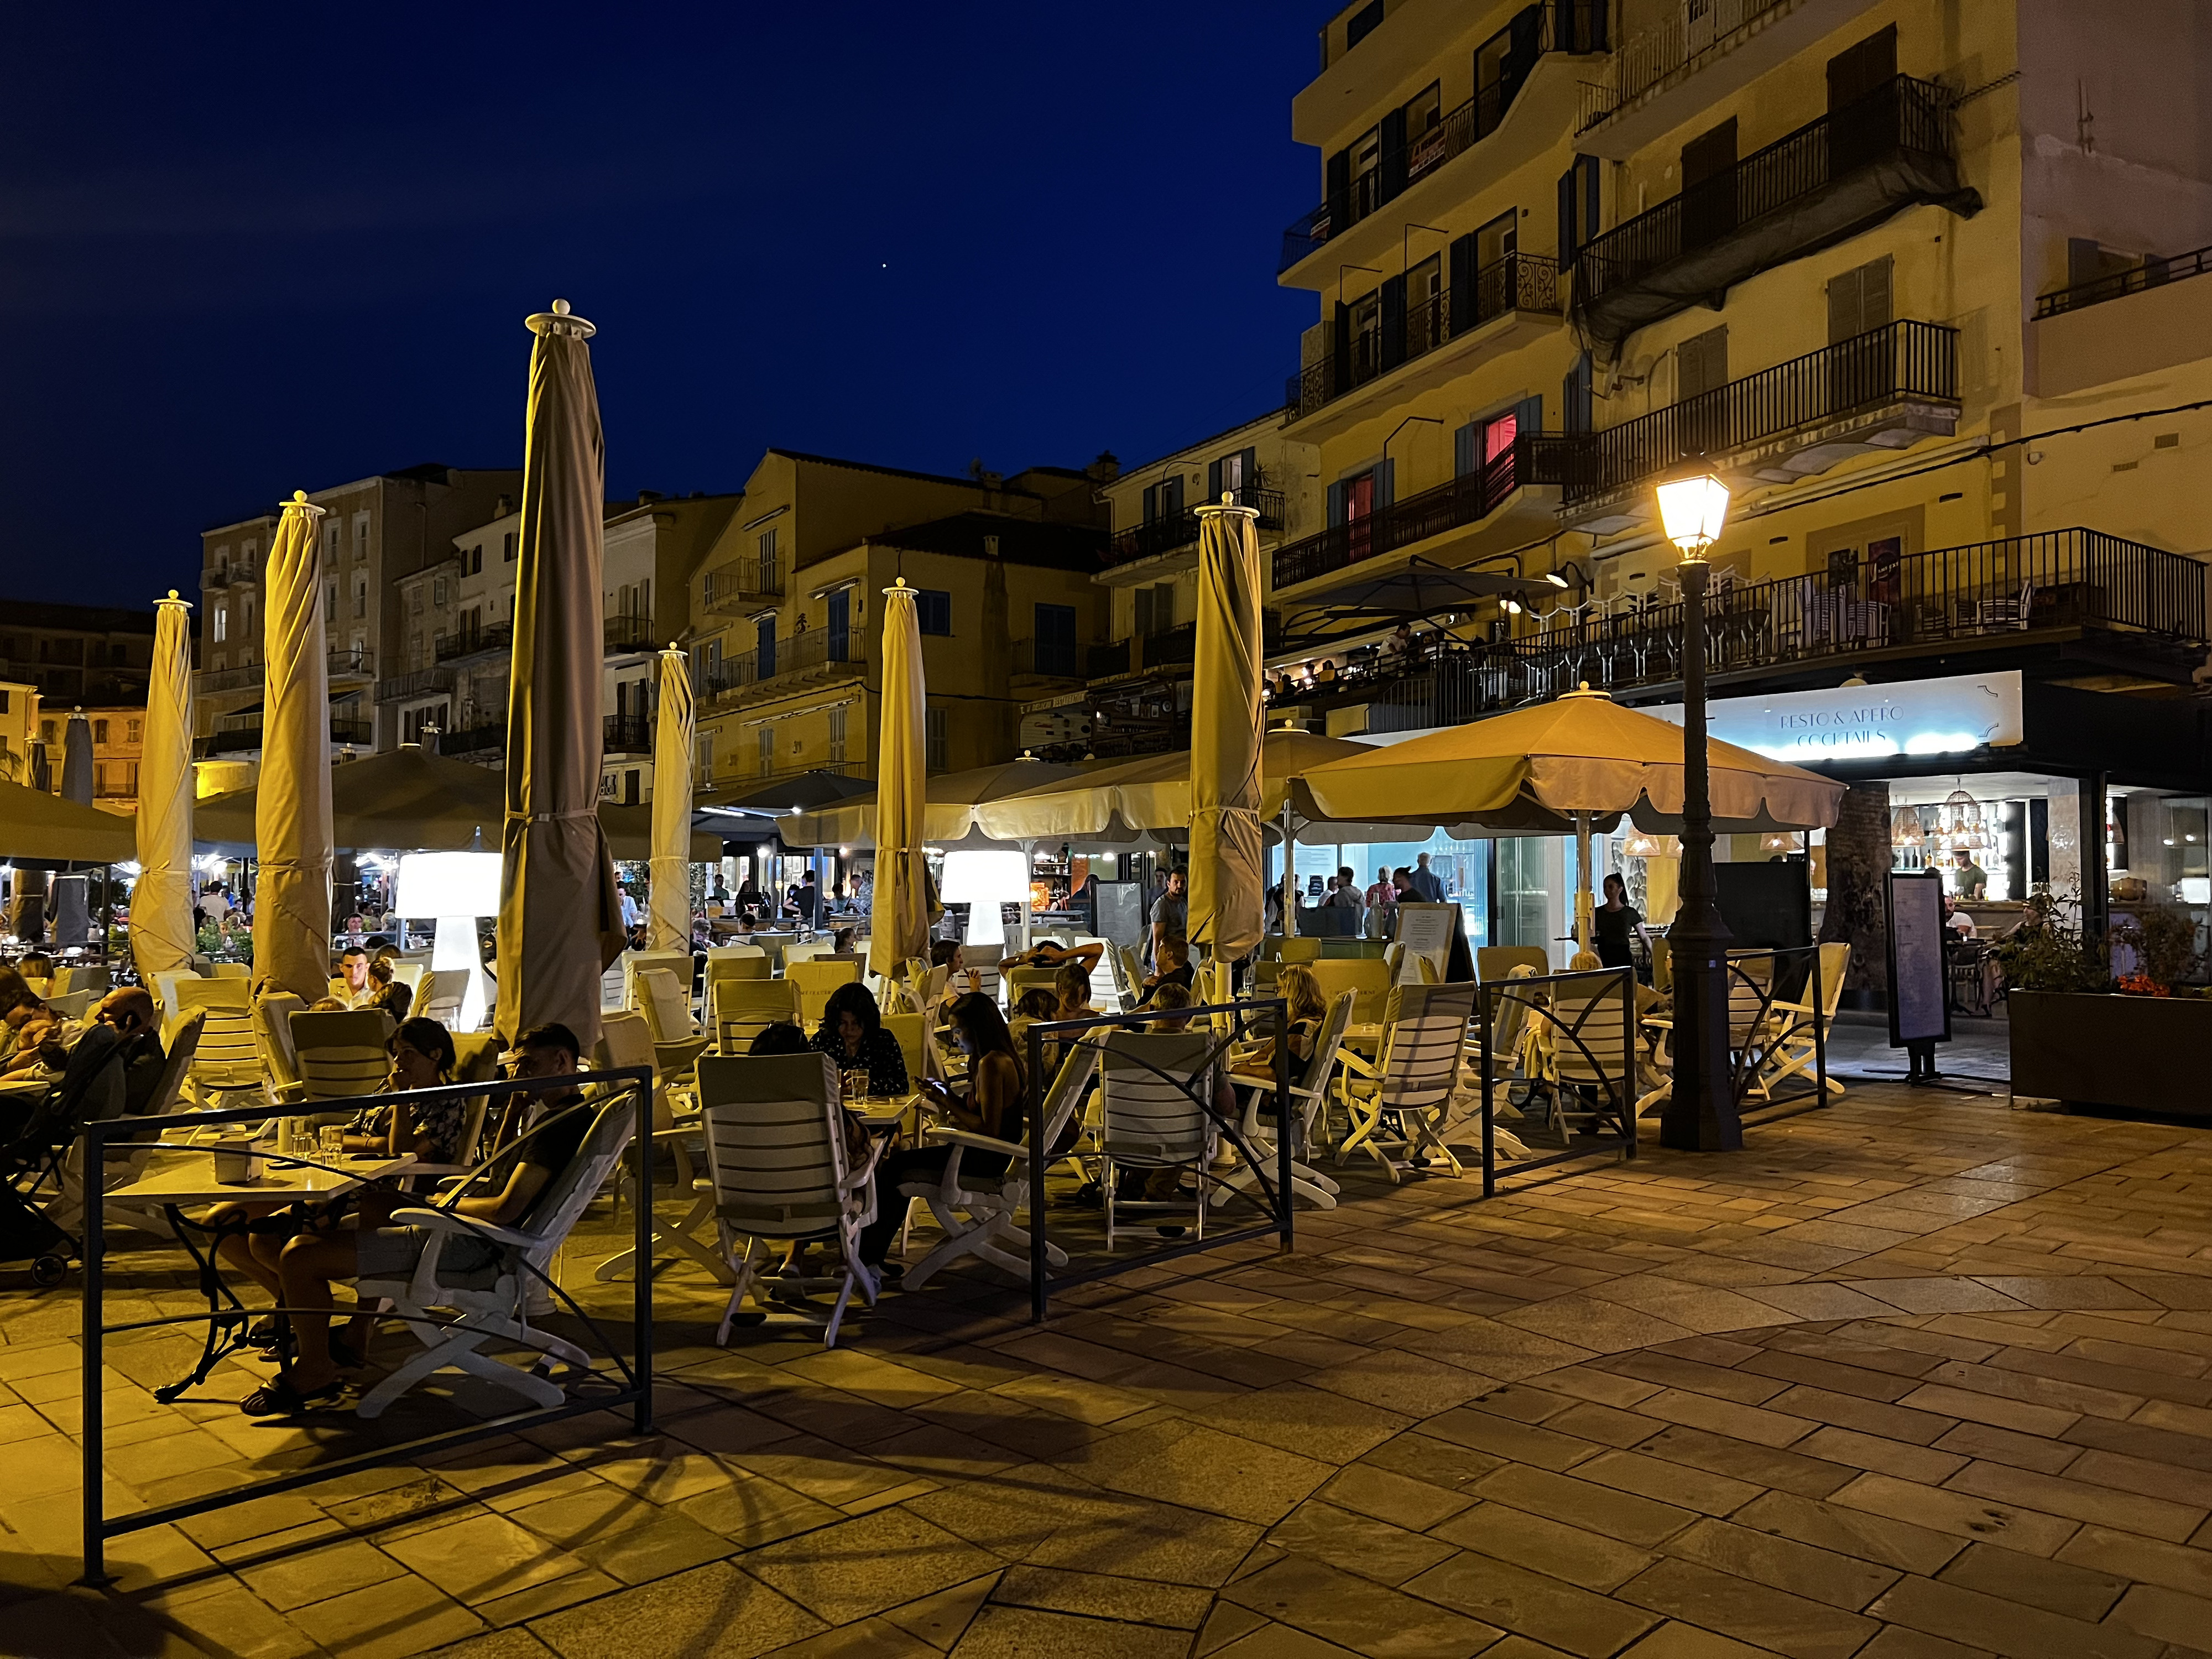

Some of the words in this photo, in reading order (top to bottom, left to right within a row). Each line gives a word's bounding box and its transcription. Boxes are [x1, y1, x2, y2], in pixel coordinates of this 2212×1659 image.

[1781, 712, 1829, 729] RESTO
[1834, 711, 1844, 725] &
[1849, 706, 1904, 723] APERO
